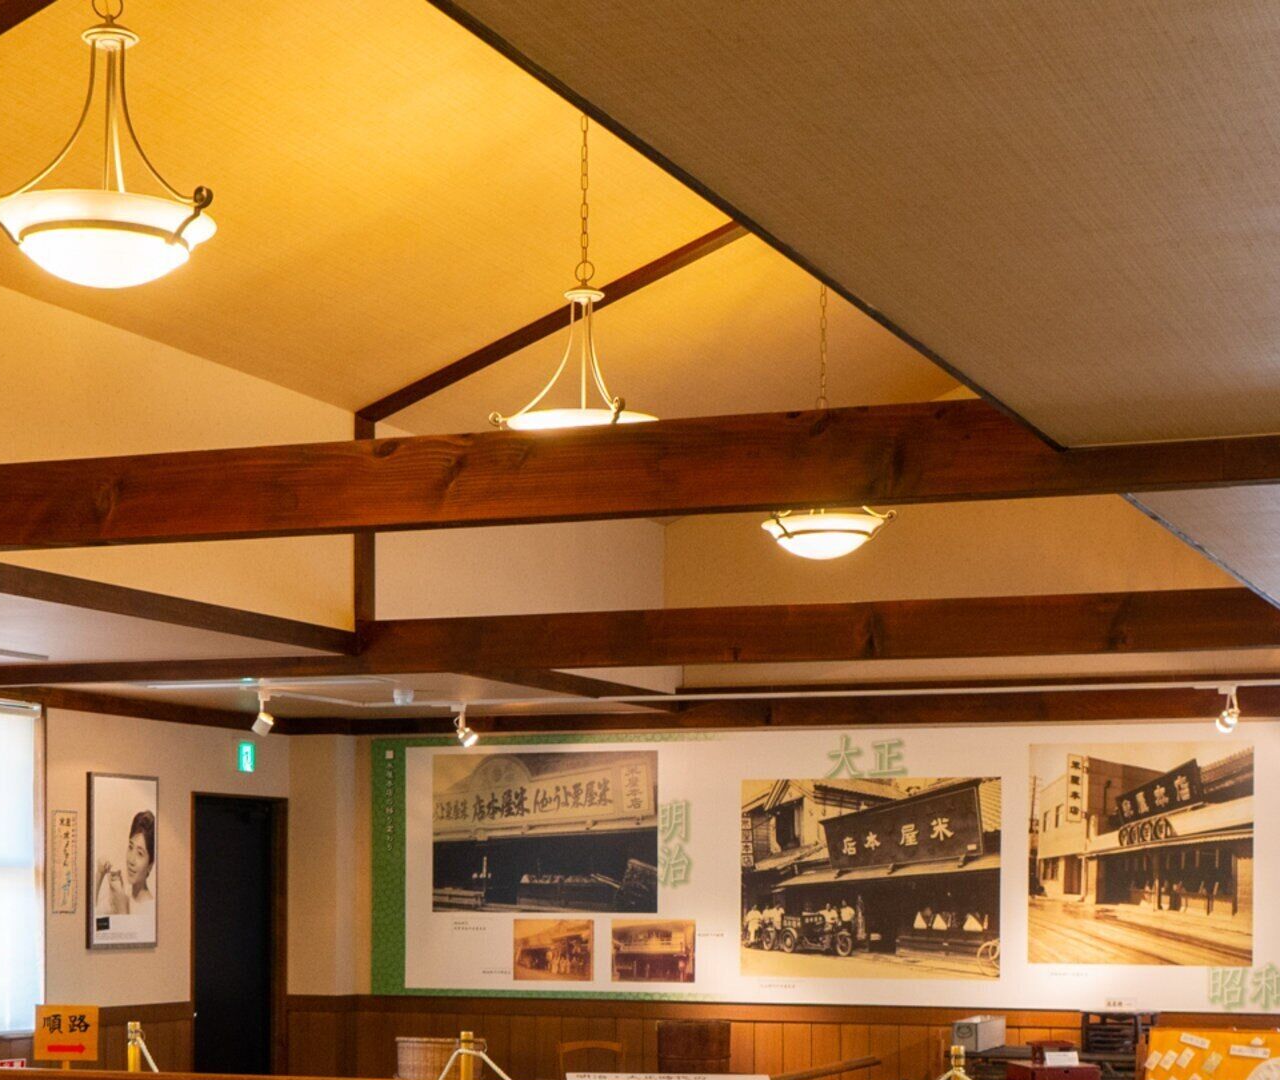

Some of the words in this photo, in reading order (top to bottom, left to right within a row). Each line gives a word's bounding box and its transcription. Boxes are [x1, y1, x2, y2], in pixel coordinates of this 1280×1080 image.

[826, 735, 907, 777] 大正
[658, 800, 690, 887] 明治
[841, 817, 955, 857] 米屋本店
[43, 1014, 90, 1034] 順路
